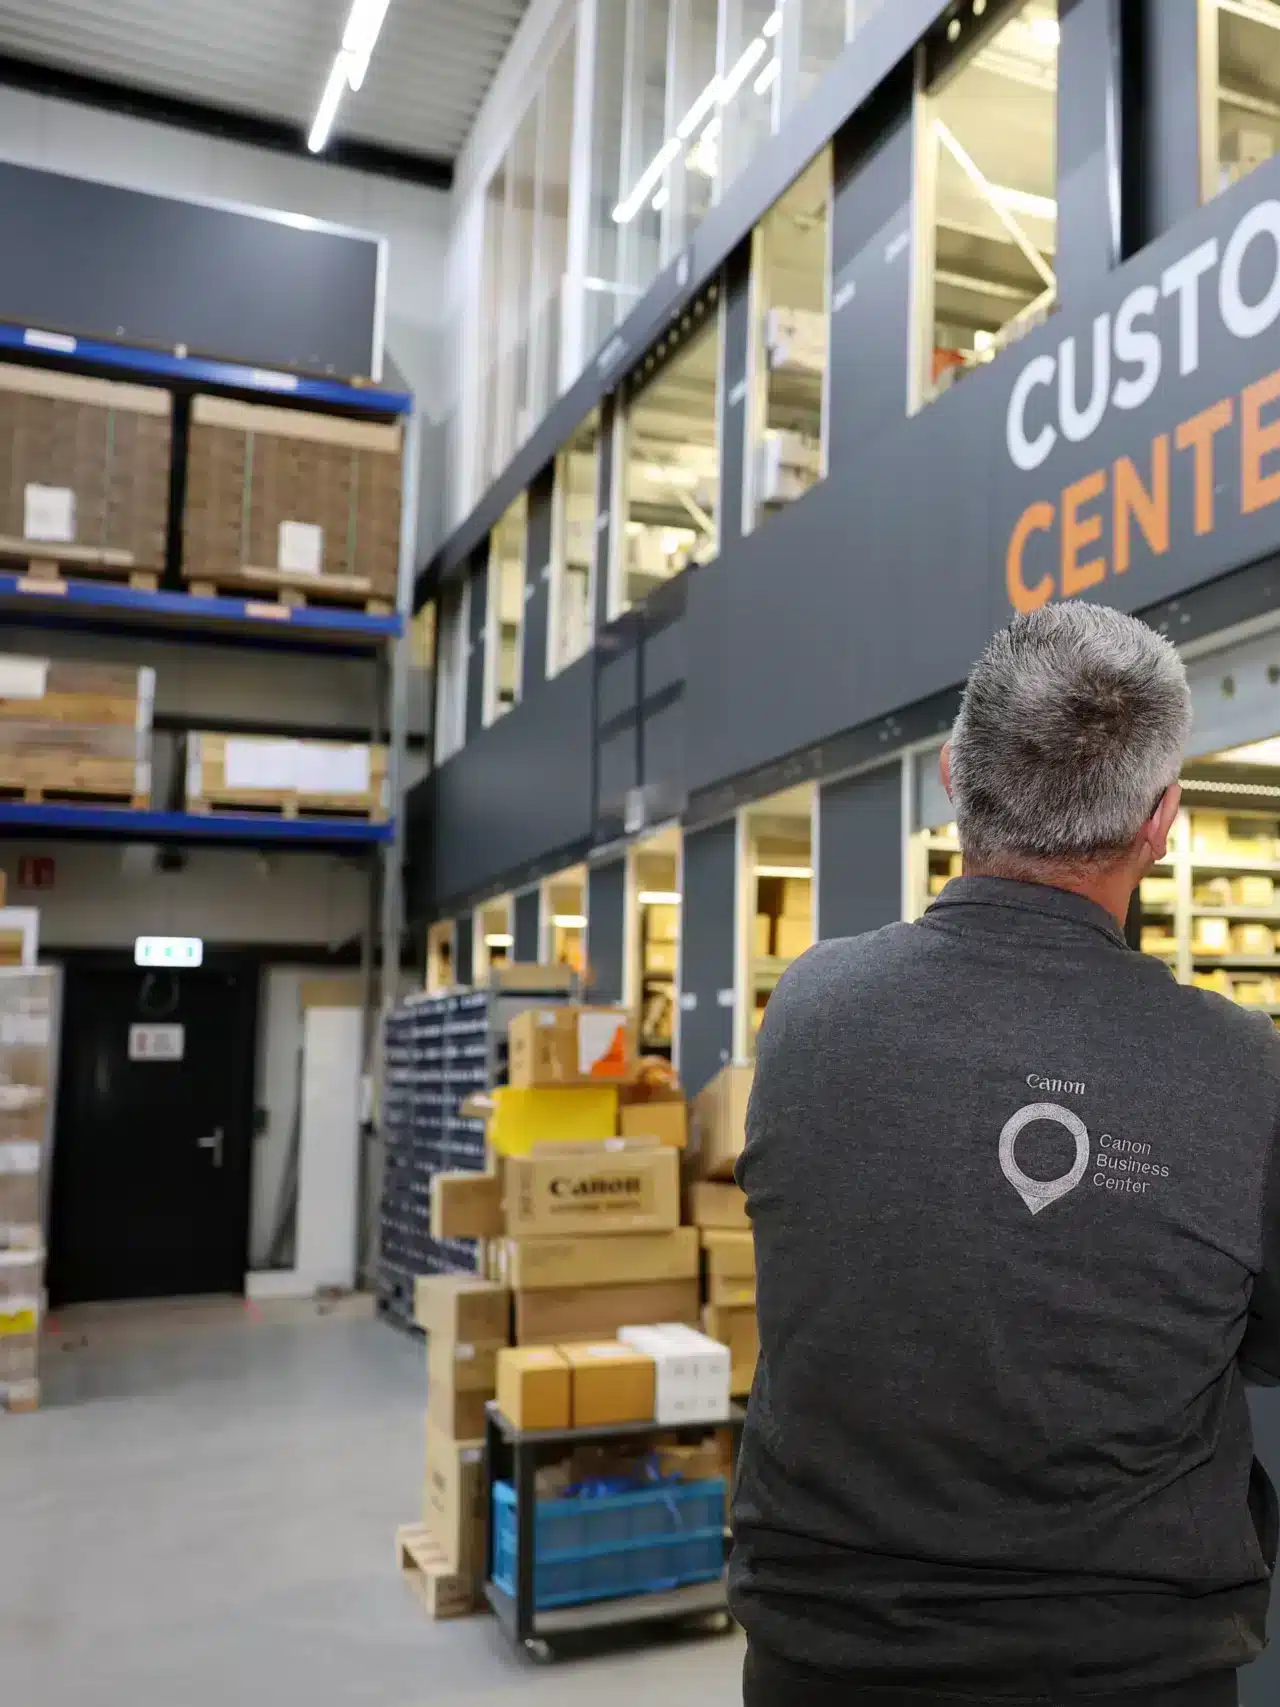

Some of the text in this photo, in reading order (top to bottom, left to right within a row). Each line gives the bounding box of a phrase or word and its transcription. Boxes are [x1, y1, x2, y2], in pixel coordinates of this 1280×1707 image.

[1025, 1073, 1086, 1095] Canon
[1099, 1133, 1151, 1155] Canon
[1096, 1153, 1169, 1177] Business
[549, 1176, 641, 1198] Canon
[1093, 1172, 1151, 1193] Center
